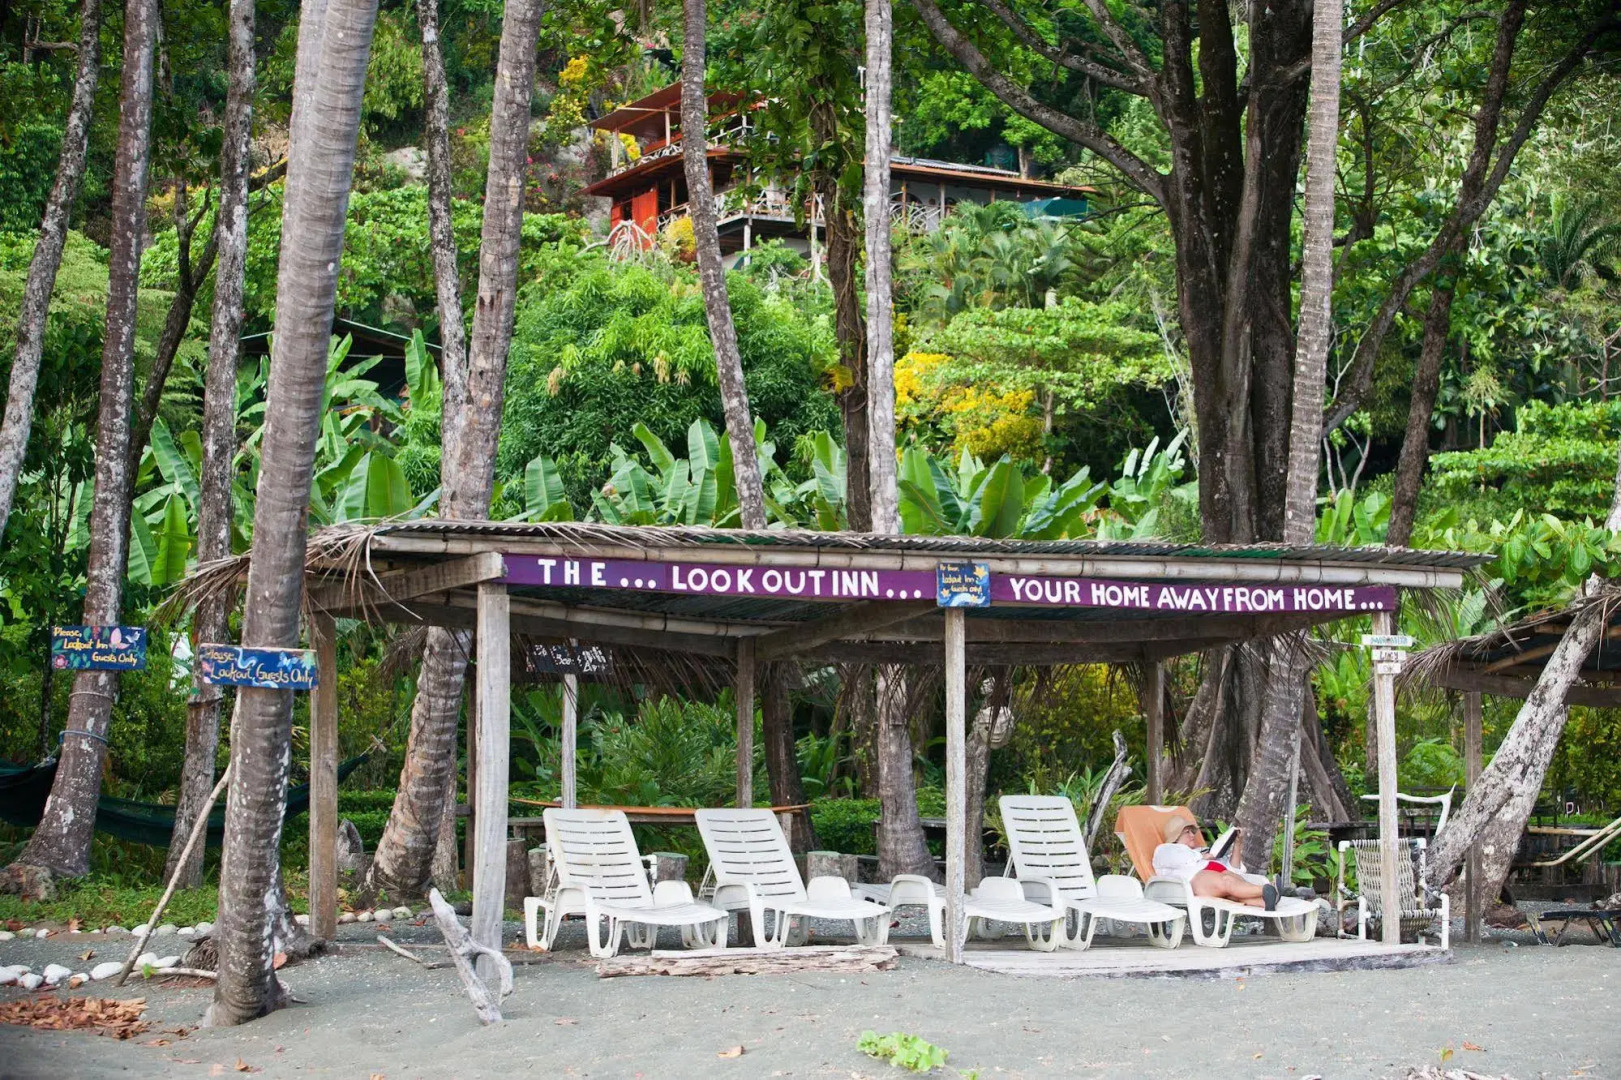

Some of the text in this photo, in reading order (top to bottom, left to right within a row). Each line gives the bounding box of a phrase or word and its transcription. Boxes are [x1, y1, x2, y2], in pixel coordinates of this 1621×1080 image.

[538, 558, 606, 587] THE
[1009, 578, 1081, 603] YOUR
[1090, 583, 1150, 607] HOME
[63, 638, 108, 651] Lookout Inn
[92, 651, 138, 667] Guests Only
[256, 663, 290, 683] Guests
[290, 668, 314, 688] Only
